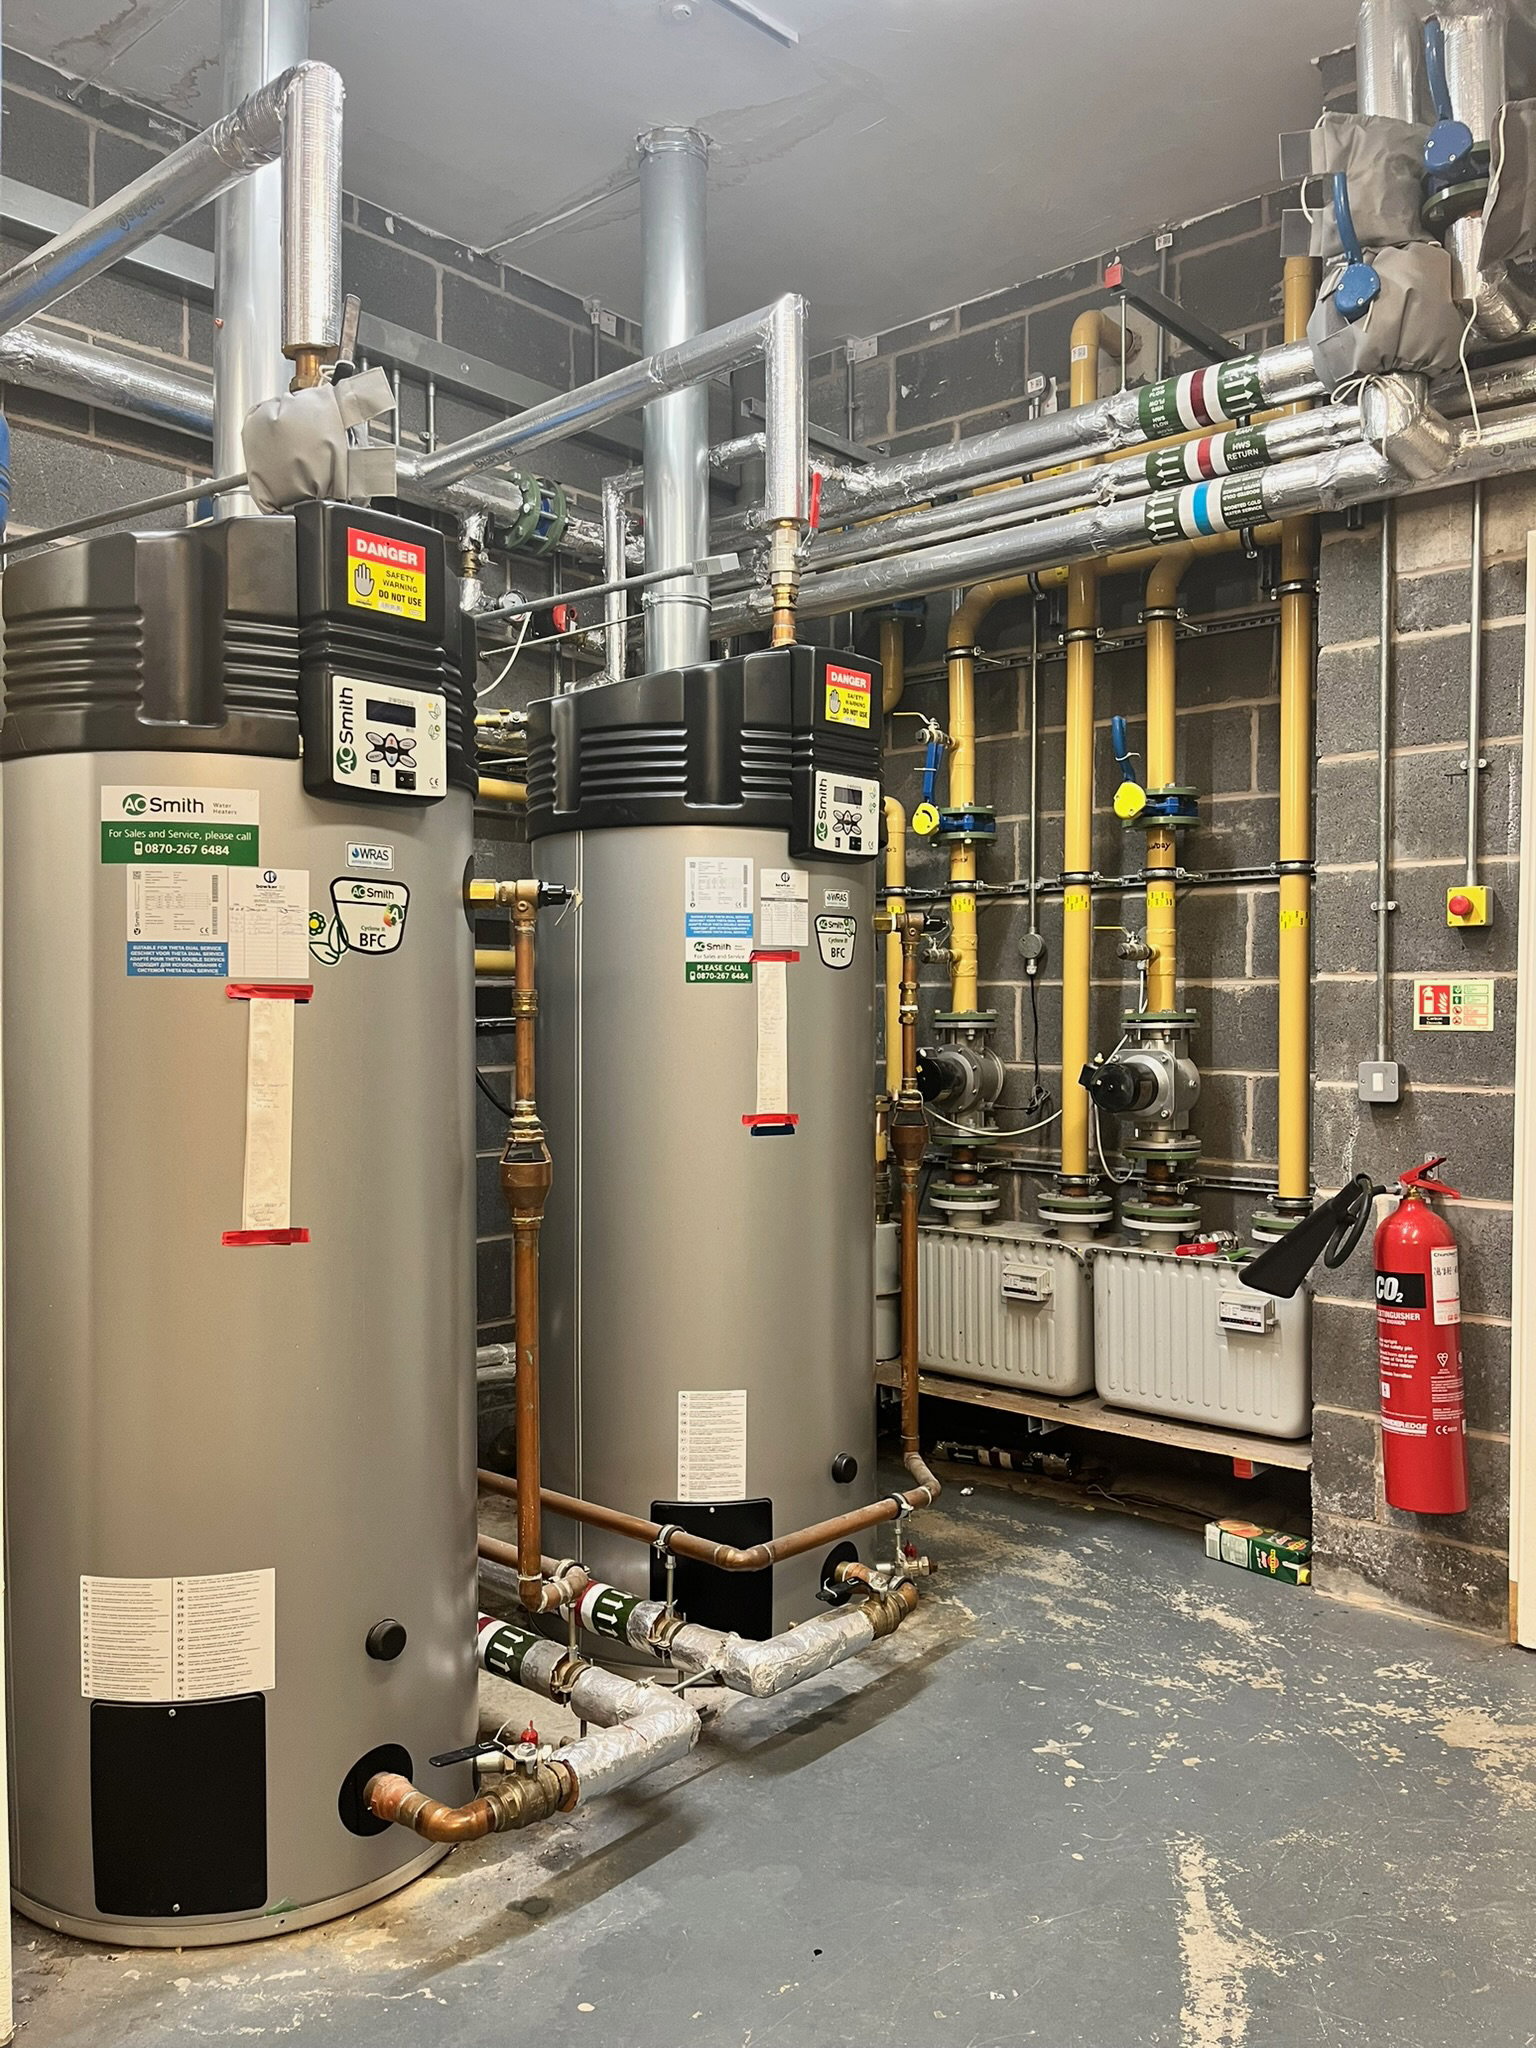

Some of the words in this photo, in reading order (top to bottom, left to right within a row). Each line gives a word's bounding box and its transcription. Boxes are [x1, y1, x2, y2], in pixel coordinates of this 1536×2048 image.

[1232, 440, 1251, 451] HWS
[1226, 448, 1259, 461] RETURN
[1224, 509, 1241, 517] WATER
[1242, 505, 1263, 514] SERVICE
[356, 538, 418, 566] DANGER
[386, 570, 415, 583] SAFETY
[383, 579, 418, 593] WARNING
[378, 589, 389, 599] DO
[391, 593, 405, 603] NOT
[408, 597, 422, 607] USE
[831, 672, 867, 688] DANGER
[339, 687, 353, 745] Smith
[150, 797, 204, 813] Smith
[818, 778, 828, 820] Smith
[108, 829, 123, 838] For
[124, 829, 147, 839] Sales
[149, 829, 166, 839] and
[168, 830, 202, 841] Service,
[204, 831, 234, 842] please
[235, 832, 252, 841] call
[144, 843, 198, 854] 0870-267
[201, 845, 230, 856] 6484
[360, 847, 389, 861] WRAS
[366, 888, 395, 900] Smith
[831, 893, 847, 902] WRAS
[360, 924, 380, 932] Cyclone
[828, 920, 844, 929] Smith
[359, 933, 387, 948] BFC
[706, 943, 732, 951] Smith
[830, 947, 846, 958] BFC
[724, 964, 742, 972] CALL
[696, 972, 730, 980] 0870-267
